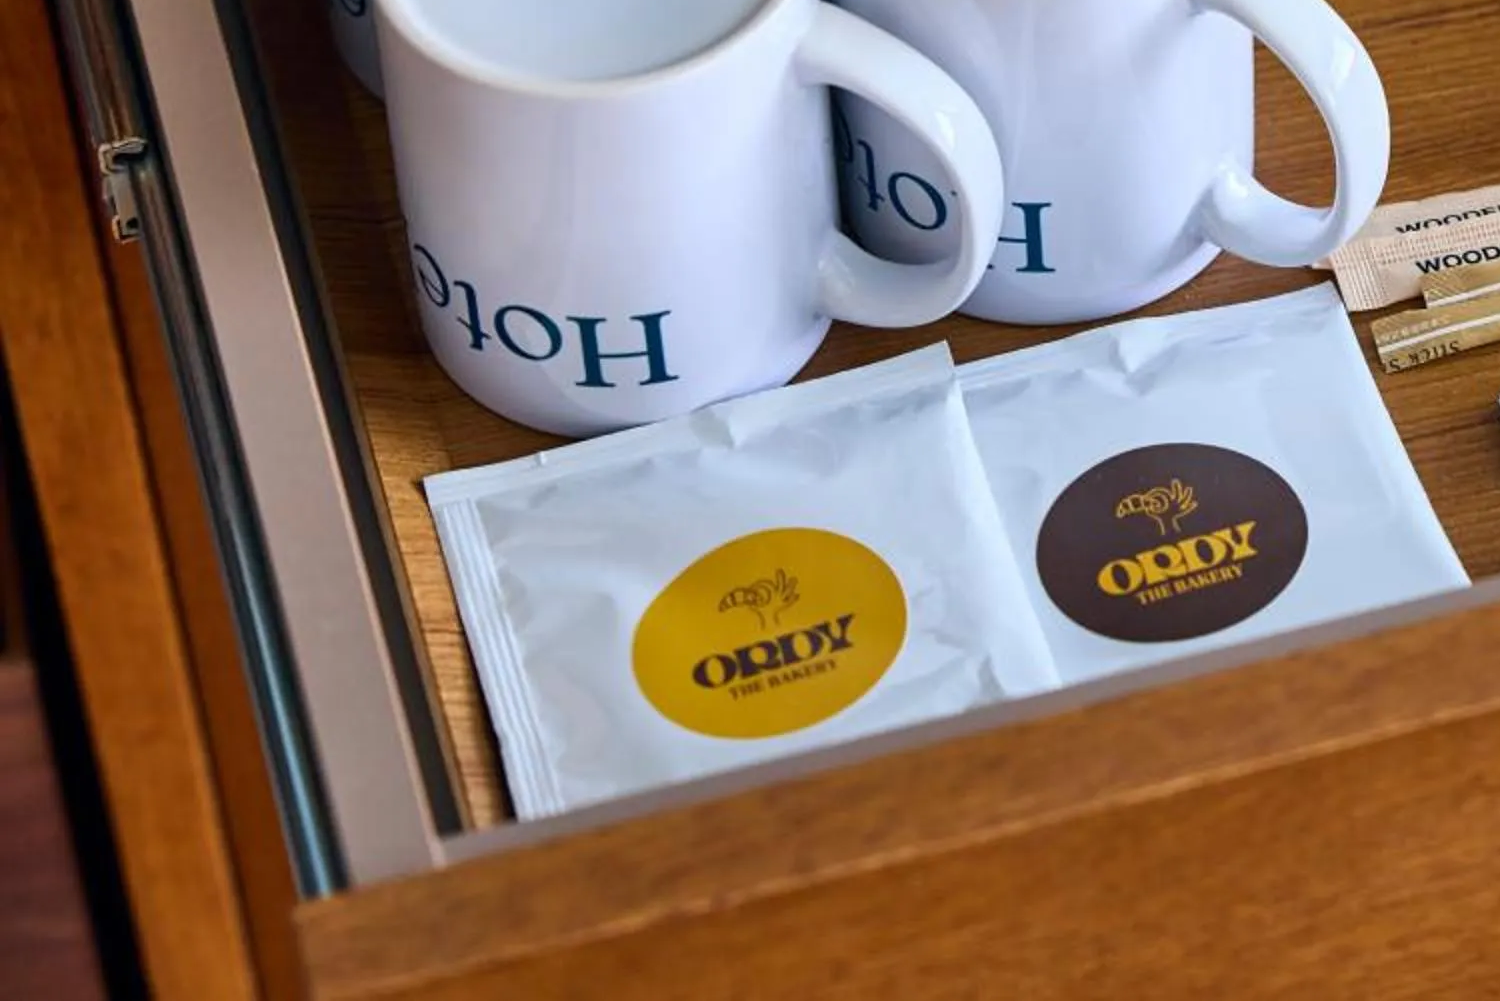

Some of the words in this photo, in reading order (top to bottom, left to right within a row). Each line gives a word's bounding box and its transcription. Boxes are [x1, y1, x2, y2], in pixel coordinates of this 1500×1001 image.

[1097, 520, 1257, 596] ORDY
[1136, 582, 1173, 605] THE
[1173, 564, 1242, 594] BAKERY
[692, 613, 855, 689] ORDY
[728, 679, 764, 701] THE
[766, 659, 836, 689] BAKERY
